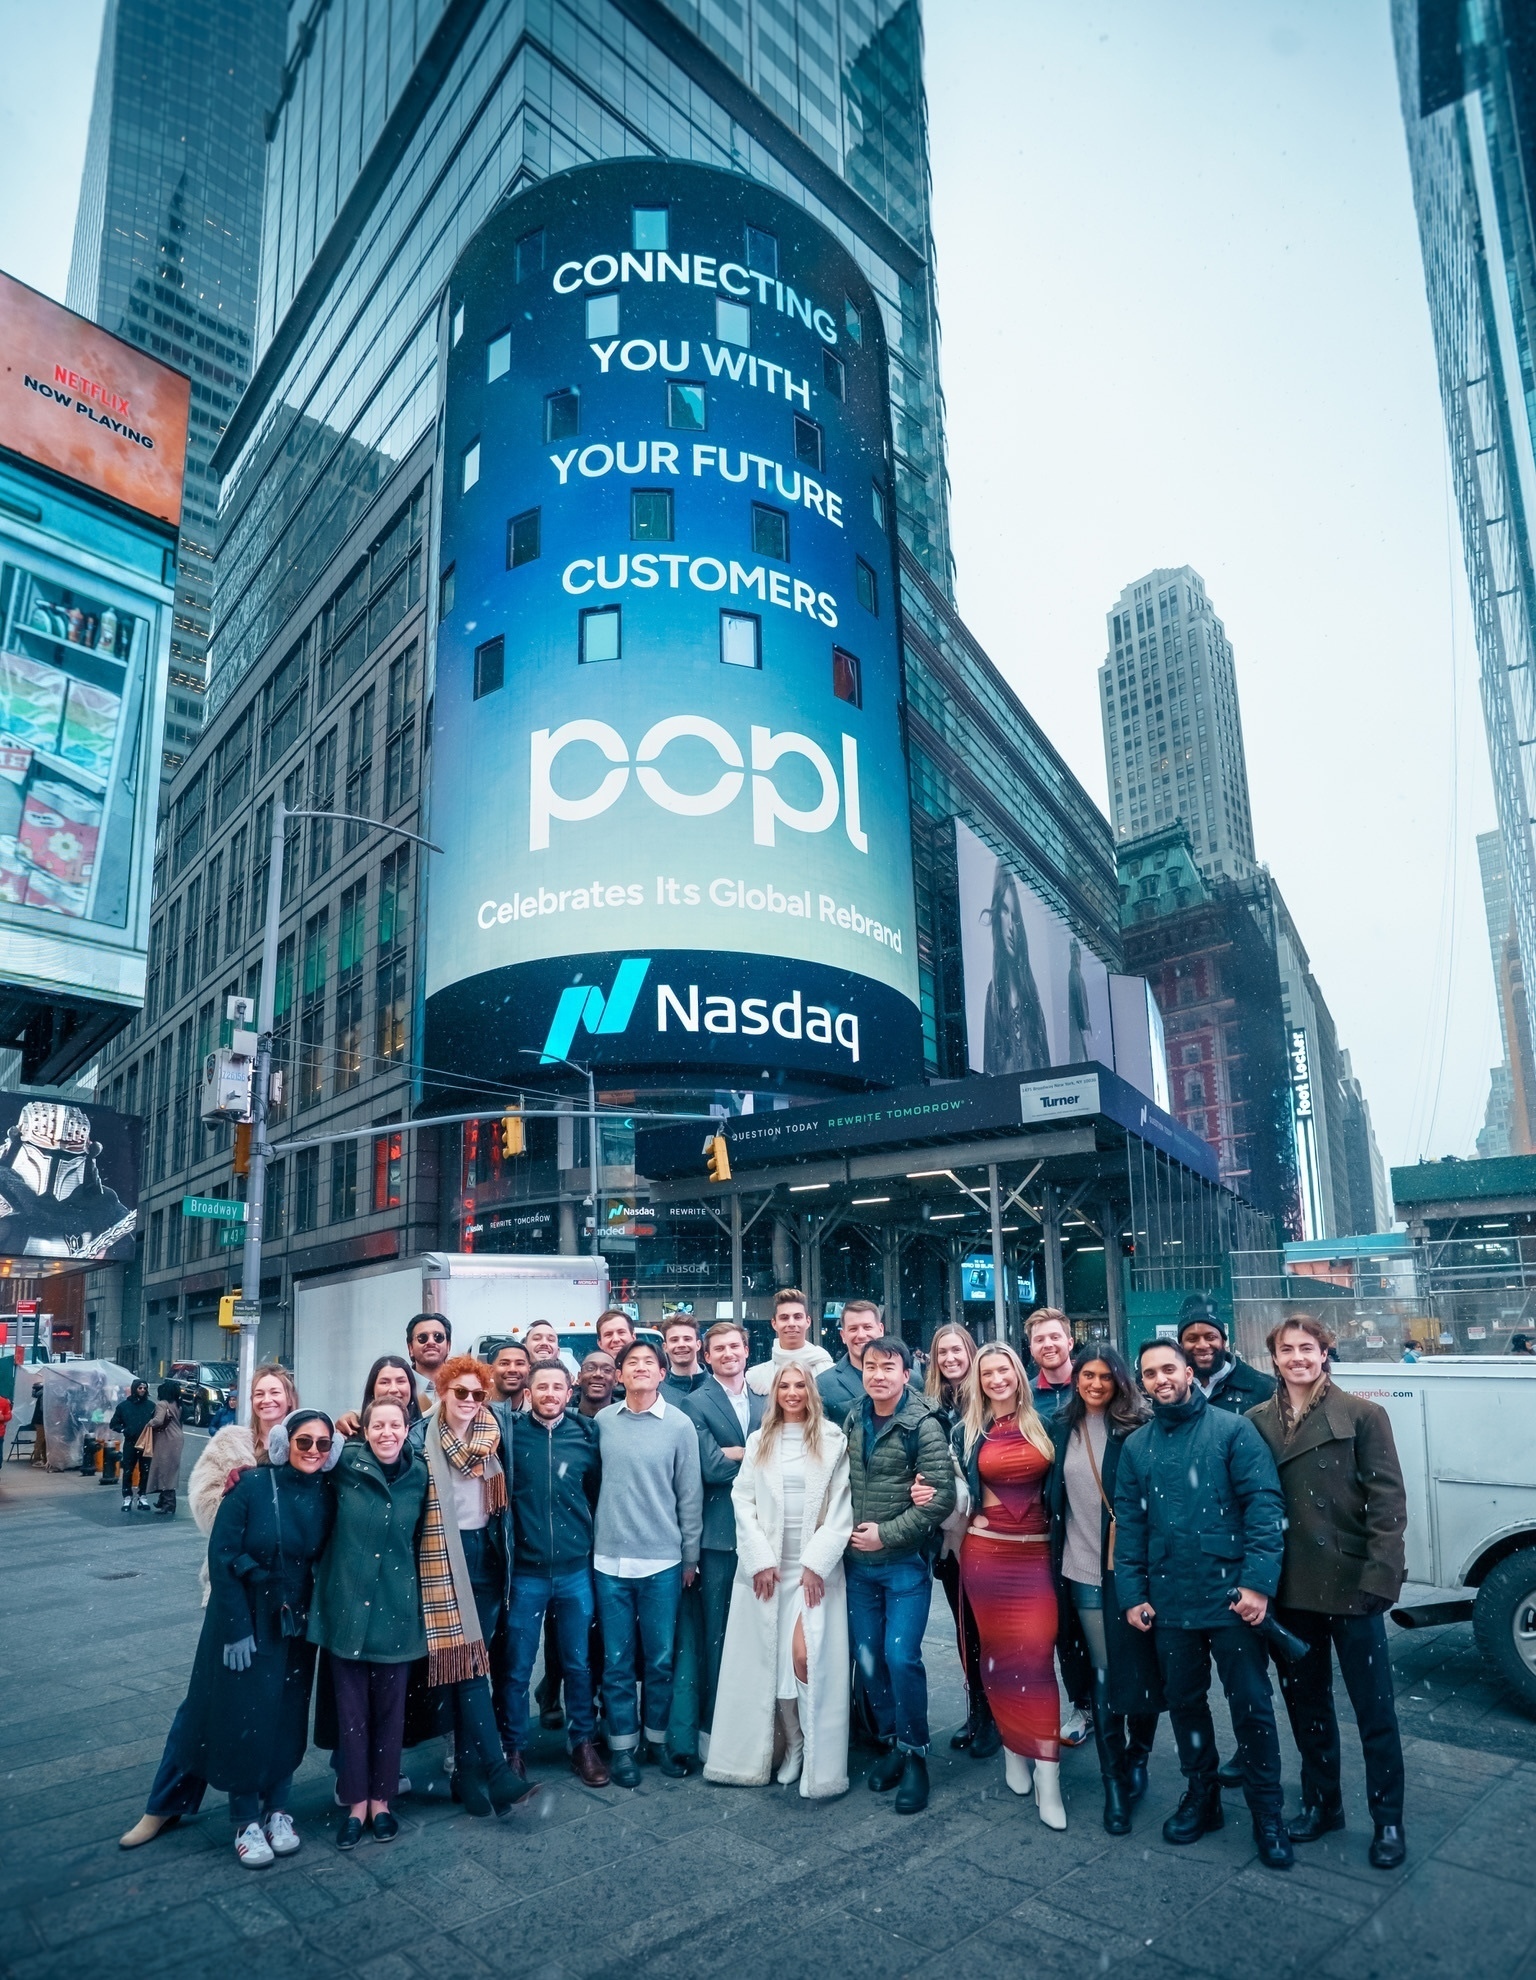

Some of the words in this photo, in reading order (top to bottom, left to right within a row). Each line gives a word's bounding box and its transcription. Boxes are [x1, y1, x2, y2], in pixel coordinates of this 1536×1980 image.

[552, 251, 838, 345] CONNECTING
[54, 364, 130, 417] NETFLIX
[589, 338, 689, 373] YOU
[701, 342, 811, 411] WITH
[24, 375, 72, 407] NOW
[76, 402, 154, 449] PLAYING
[549, 440, 680, 485] YOUR
[692, 443, 844, 529] FUTURE
[561, 552, 839, 629] CUSTOMERS
[529, 714, 869, 855] popl
[477, 881, 644, 930] Celebrates
[656, 876, 701, 906] Its
[708, 877, 811, 919] Global
[819, 894, 903, 955] Rebrand
[657, 984, 860, 1063] Nasdaq
[1291, 1031, 1308, 1081] Locker
[1040, 1095, 1080, 1108] Turner
[1295, 1083, 1312, 1116] Foot
[732, 1127, 781, 1141] QUESTION
[785, 1121, 819, 1133] TODAY
[828, 1112, 882, 1128] REWRITE
[191, 1199, 238, 1219] Broadway
[623, 1206, 655, 1216] Nasdaq
[670, 1208, 706, 1216] REWRITE
[223, 1230, 229, 1244] W
[230, 1229, 239, 1243] 43
[666, 1262, 710, 1275] Nasdaq
